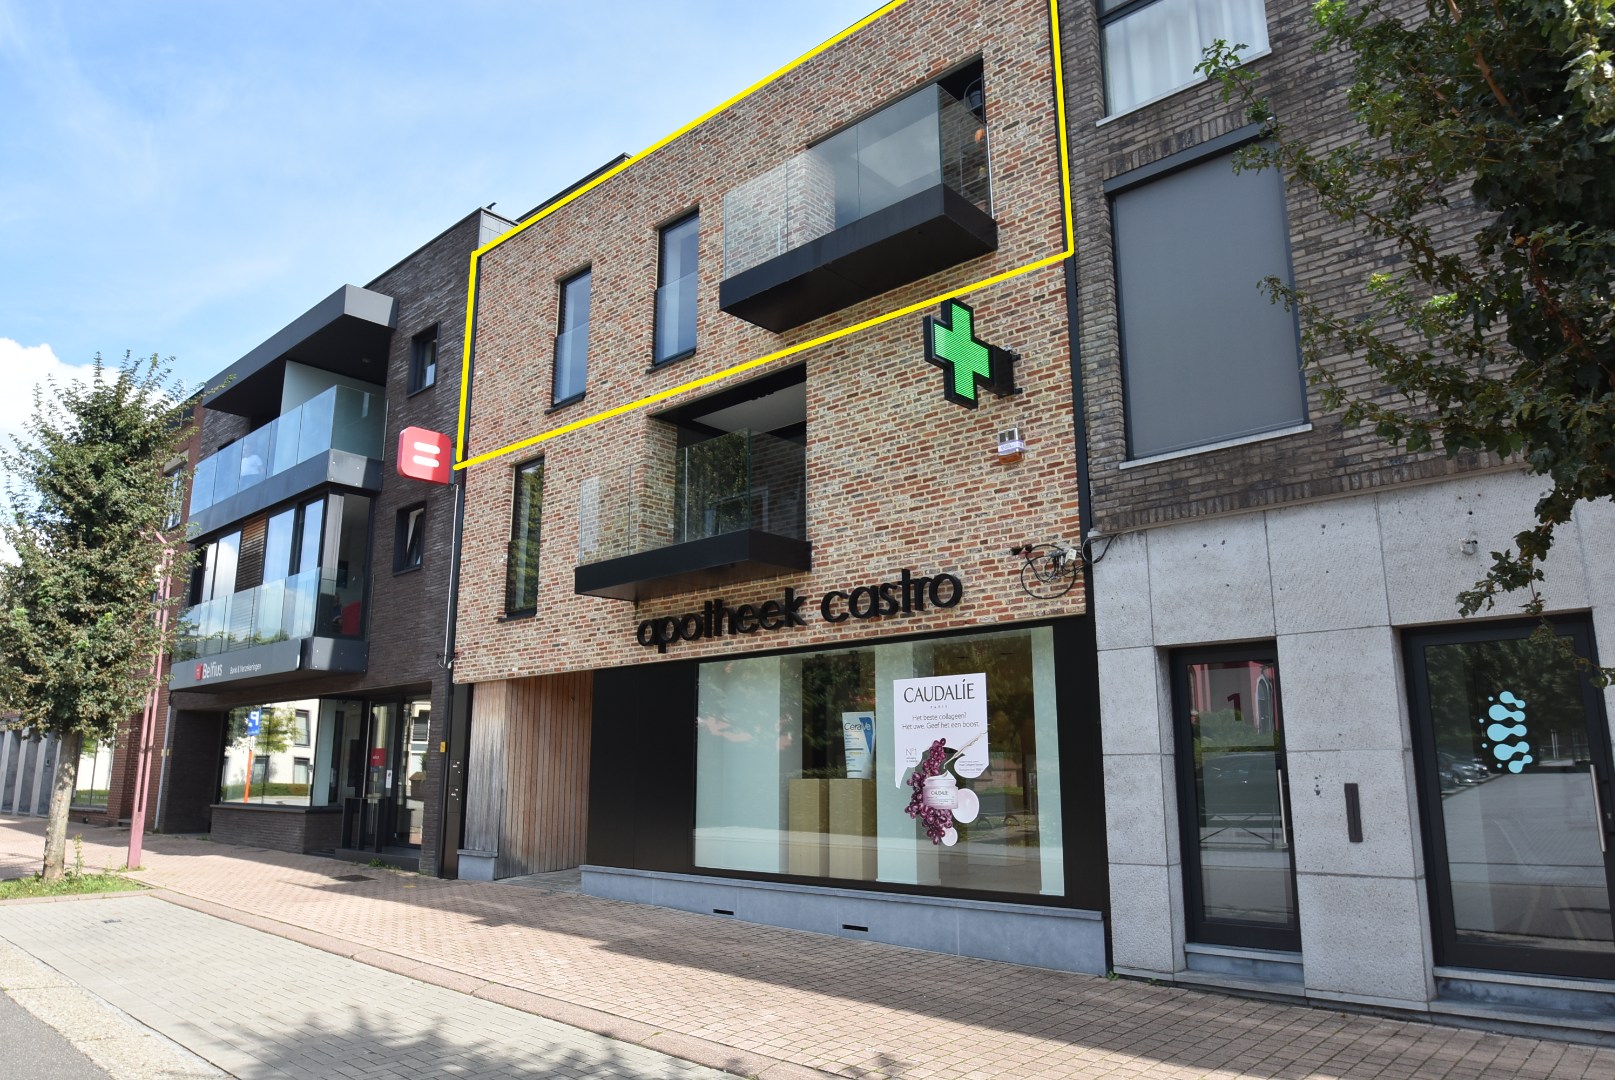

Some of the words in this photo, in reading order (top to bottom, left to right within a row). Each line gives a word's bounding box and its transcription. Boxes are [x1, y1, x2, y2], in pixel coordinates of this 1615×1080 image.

[637, 587, 807, 653] apotheek
[820, 568, 963, 623] castro
[203, 661, 223, 679] Belfius
[1227, 692, 1242, 721] 1
[923, 713, 938, 721] beste
[939, 711, 967, 721] collageen?
[844, 722, 871, 731] CeraVe
[902, 722, 912, 730] Het
[926, 721, 940, 730] Geef
[940, 721, 950, 729] het
